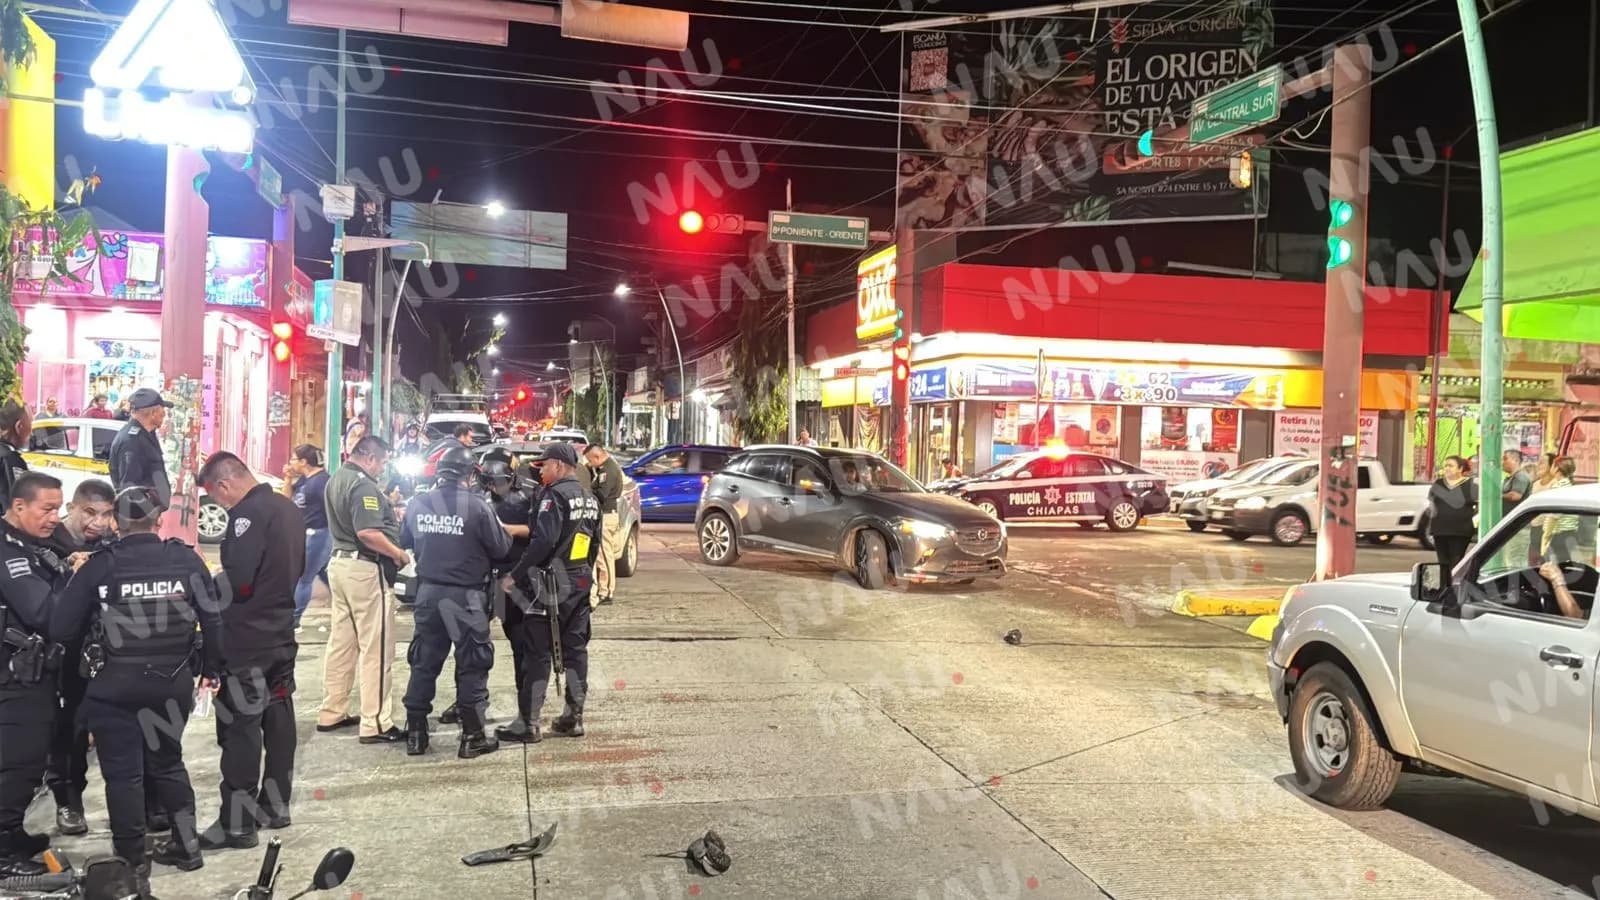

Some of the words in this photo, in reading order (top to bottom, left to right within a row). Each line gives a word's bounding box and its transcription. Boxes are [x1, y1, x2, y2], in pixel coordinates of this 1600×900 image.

[1188, 16, 1247, 33] ORIGEN
[1106, 57, 1140, 84] EL
[1145, 49, 1258, 81] ORIGEN
[1105, 85, 1132, 106] DE
[1135, 82, 1164, 104] TU
[1252, 92, 1275, 112] SUR
[1104, 101, 1177, 135] ESTÁ
[780, 226, 824, 238] PONIENTE
[829, 230, 864, 241] ORIENTE
[1280, 416, 1308, 425] Retira
[1009, 488, 1041, 505] POLICÍA
[1065, 491, 1096, 504] ESTATAL
[1027, 505, 1080, 516] CHIAPAS
[416, 513, 464, 527] POLICÍA
[418, 523, 464, 536] MUNICIPAL
[121, 580, 185, 597] POLICIA
